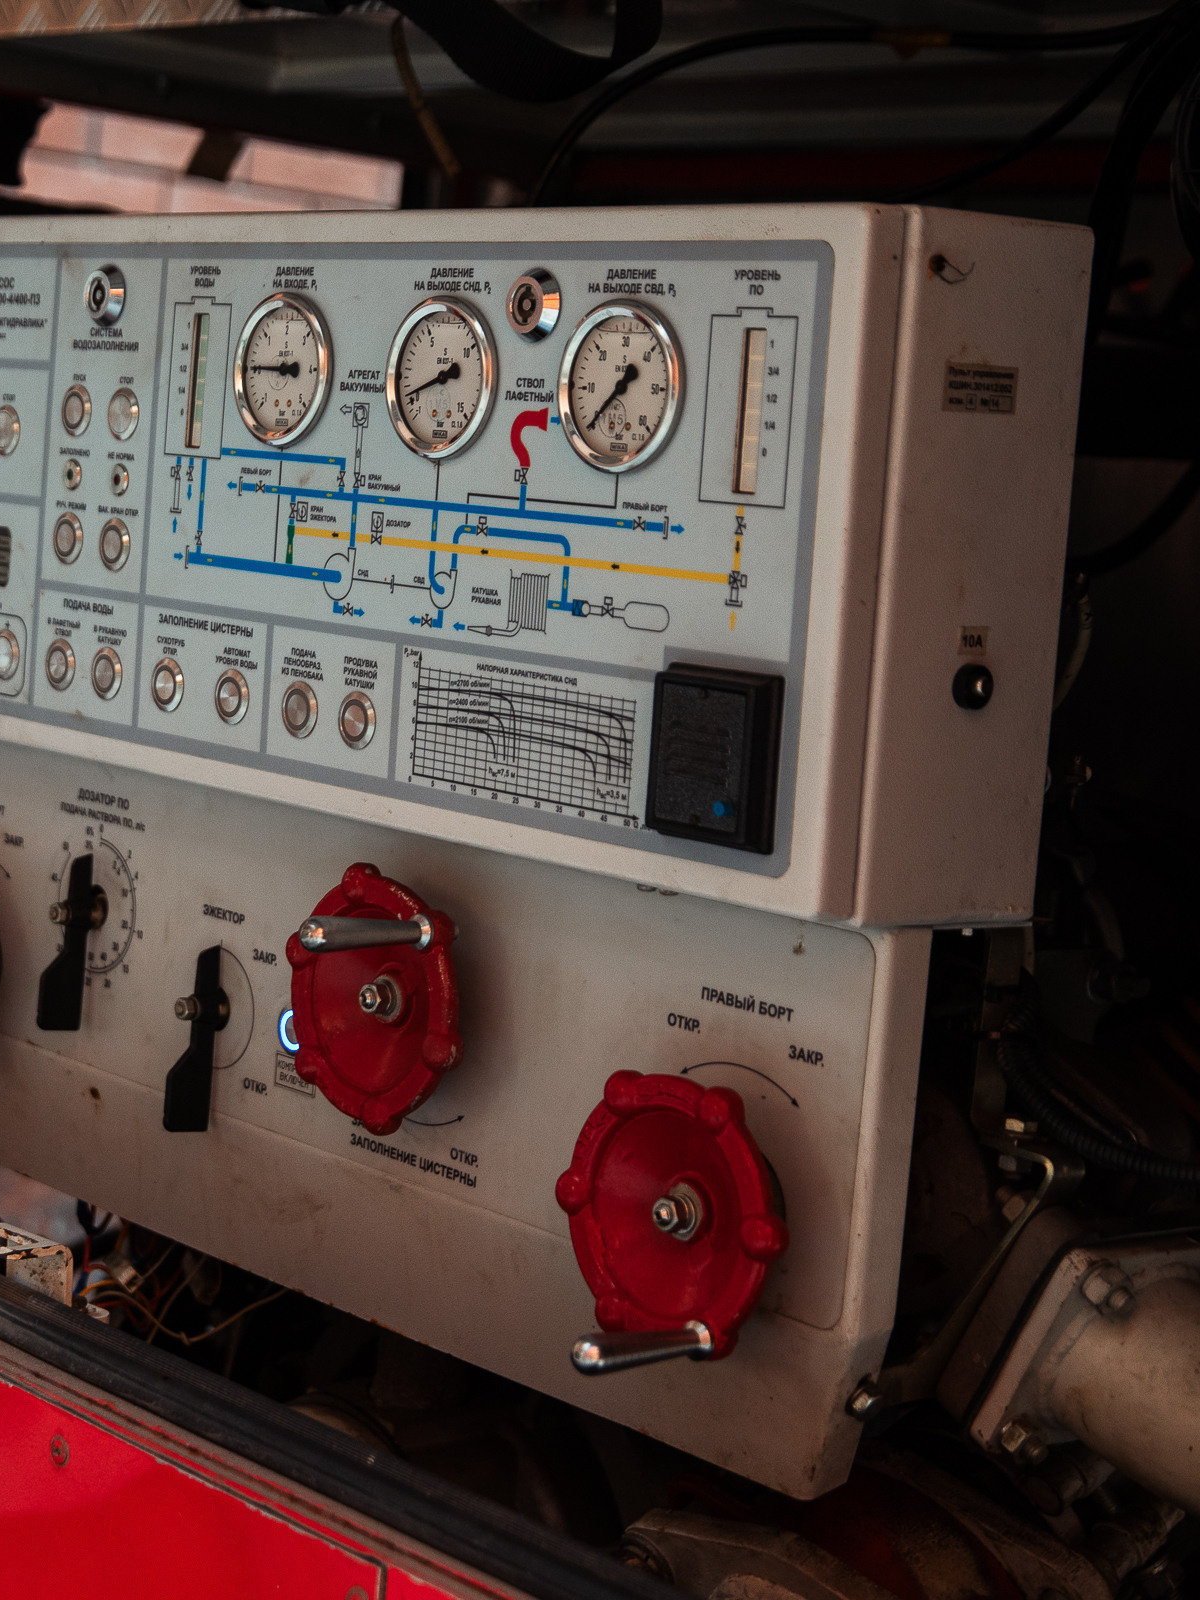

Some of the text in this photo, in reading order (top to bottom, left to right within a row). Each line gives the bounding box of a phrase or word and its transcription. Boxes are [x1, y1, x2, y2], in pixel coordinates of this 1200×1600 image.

[190, 265, 221, 275] УРОВЕНЬ
[276, 266, 315, 277] ДАВЛЕНИЕ
[430, 268, 474, 279] ДАВЛЕНИЕ
[607, 269, 656, 280] ДАВЛЕНИЕ
[735, 270, 781, 281] УРОВЕНЬ
[195, 278, 215, 288] ВОДЫ
[273, 278, 283, 288] НА
[284, 279, 309, 290] ВХОДЕ,
[414, 281, 482, 293] НА ВЫХОДЕ СНД,
[588, 283, 600, 293] НА
[603, 283, 642, 295] ВЫХОДЕ
[644, 284, 665, 296] СВД,
[749, 285, 764, 295] ПО
[90, 327, 123, 338] СИСТЕМА
[285, 325, 290, 335] 2
[73, 339, 140, 352] ВОДОЗАПОЛНЕНИЯ
[430, 337, 435, 348] 5
[621, 336, 631, 348] 30
[463, 347, 471, 359] 10
[599, 350, 607, 361] 20
[643, 351, 652, 363] 40
[348, 370, 380, 380] АГРЕГАТ
[768, 366, 780, 377] 3/4
[73, 373, 87, 382] ПУСК
[119, 376, 135, 384] СТОП
[340, 381, 386, 394] ВАКУУМНЫЙ
[516, 378, 545, 389] СТВОЛ
[587, 382, 596, 394] 10
[651, 383, 660, 395] 50
[298, 394, 303, 404] 5
[505, 390, 554, 403] ЛАФЕТНЫЙ
[766, 394, 778, 403] 1/2
[457, 402, 465, 413] 15
[638, 415, 648, 426] 60
[764, 421, 776, 430] 1/4
[240, 466, 272, 476] ЛЕВЫЙ БОРТ
[368, 474, 382, 482] КРАН
[367, 482, 401, 492] ВАКУУМНЫЙ
[111, 506, 124, 515] КРАН
[310, 505, 324, 513] КРАН
[622, 501, 668, 513] ПРАВЫЙ БОРТ
[310, 514, 337, 523] ЭЖЕКТОРА
[386, 519, 411, 528] ДОЗАТОР
[357, 569, 369, 578] СНД
[413, 576, 425, 585] СВД
[472, 587, 499, 597] КАТУШКА
[471, 596, 502, 606] РУКАВНАЯ
[63, 598, 114, 616] ПОДАЧА ВОДЫ
[159, 613, 254, 638] ЗАПОЛНЕНИЕ ЦИСТЕРНЫ
[55, 627, 72, 638] СТВОЛ
[98, 625, 127, 638] РУКАВНУЮ
[98, 635, 122, 646] КАТУШКУ
[157, 636, 185, 647] СУХОТРУБ
[961, 634, 983, 648] 10A
[162, 646, 178, 656] ОТКР.
[223, 647, 251, 659] АВТОМАТ
[291, 647, 316, 659] ПОДАЧА
[215, 655, 258, 670] УРОВНЯ ВОДЫ
[284, 656, 323, 671] ПЕНООБРАЗ.
[344, 656, 378, 670] ПРОДУВКА
[413, 661, 419, 669] 12
[281, 667, 324, 681] ИЗ ПЕНОБАКА
[343, 666, 378, 680] РУКАВНОЙ
[477, 663, 578, 687] НАПОРНАЯ ХАРАКТЕРИСТИКА СНД
[344, 677, 375, 690] КАТУШКИ
[411, 681, 418, 689] 10
[449, 698, 468, 706] n=2400
[448, 716, 468, 724] n=2100
[409, 751, 413, 759] 2
[78, 787, 130, 810] ДОЗАТОР ПО
[450, 784, 456, 792] 10
[471, 788, 477, 796] 15
[491, 792, 498, 800] 20
[534, 801, 541, 809] 30
[555, 805, 563, 813] 35
[577, 810, 585, 818] 40
[623, 819, 631, 827] 50
[60, 801, 87, 817] ПОДАЧА
[88, 807, 121, 826] РАСТВОРА
[203, 903, 245, 925] ЭЖЕКТОР
[253, 948, 278, 966] ЗАКР.
[701, 986, 794, 1022] ПРАВЫЙ БОРТ
[667, 1012, 701, 1034] ОТКР.
[788, 1045, 824, 1068] ЗАКР.
[243, 1077, 268, 1096] ОТКР.
[350, 1133, 477, 1189] ЗАПОЛНЕНИЕ ЦИСТЕРНЫ
[450, 1147, 479, 1168] ОТКР.
